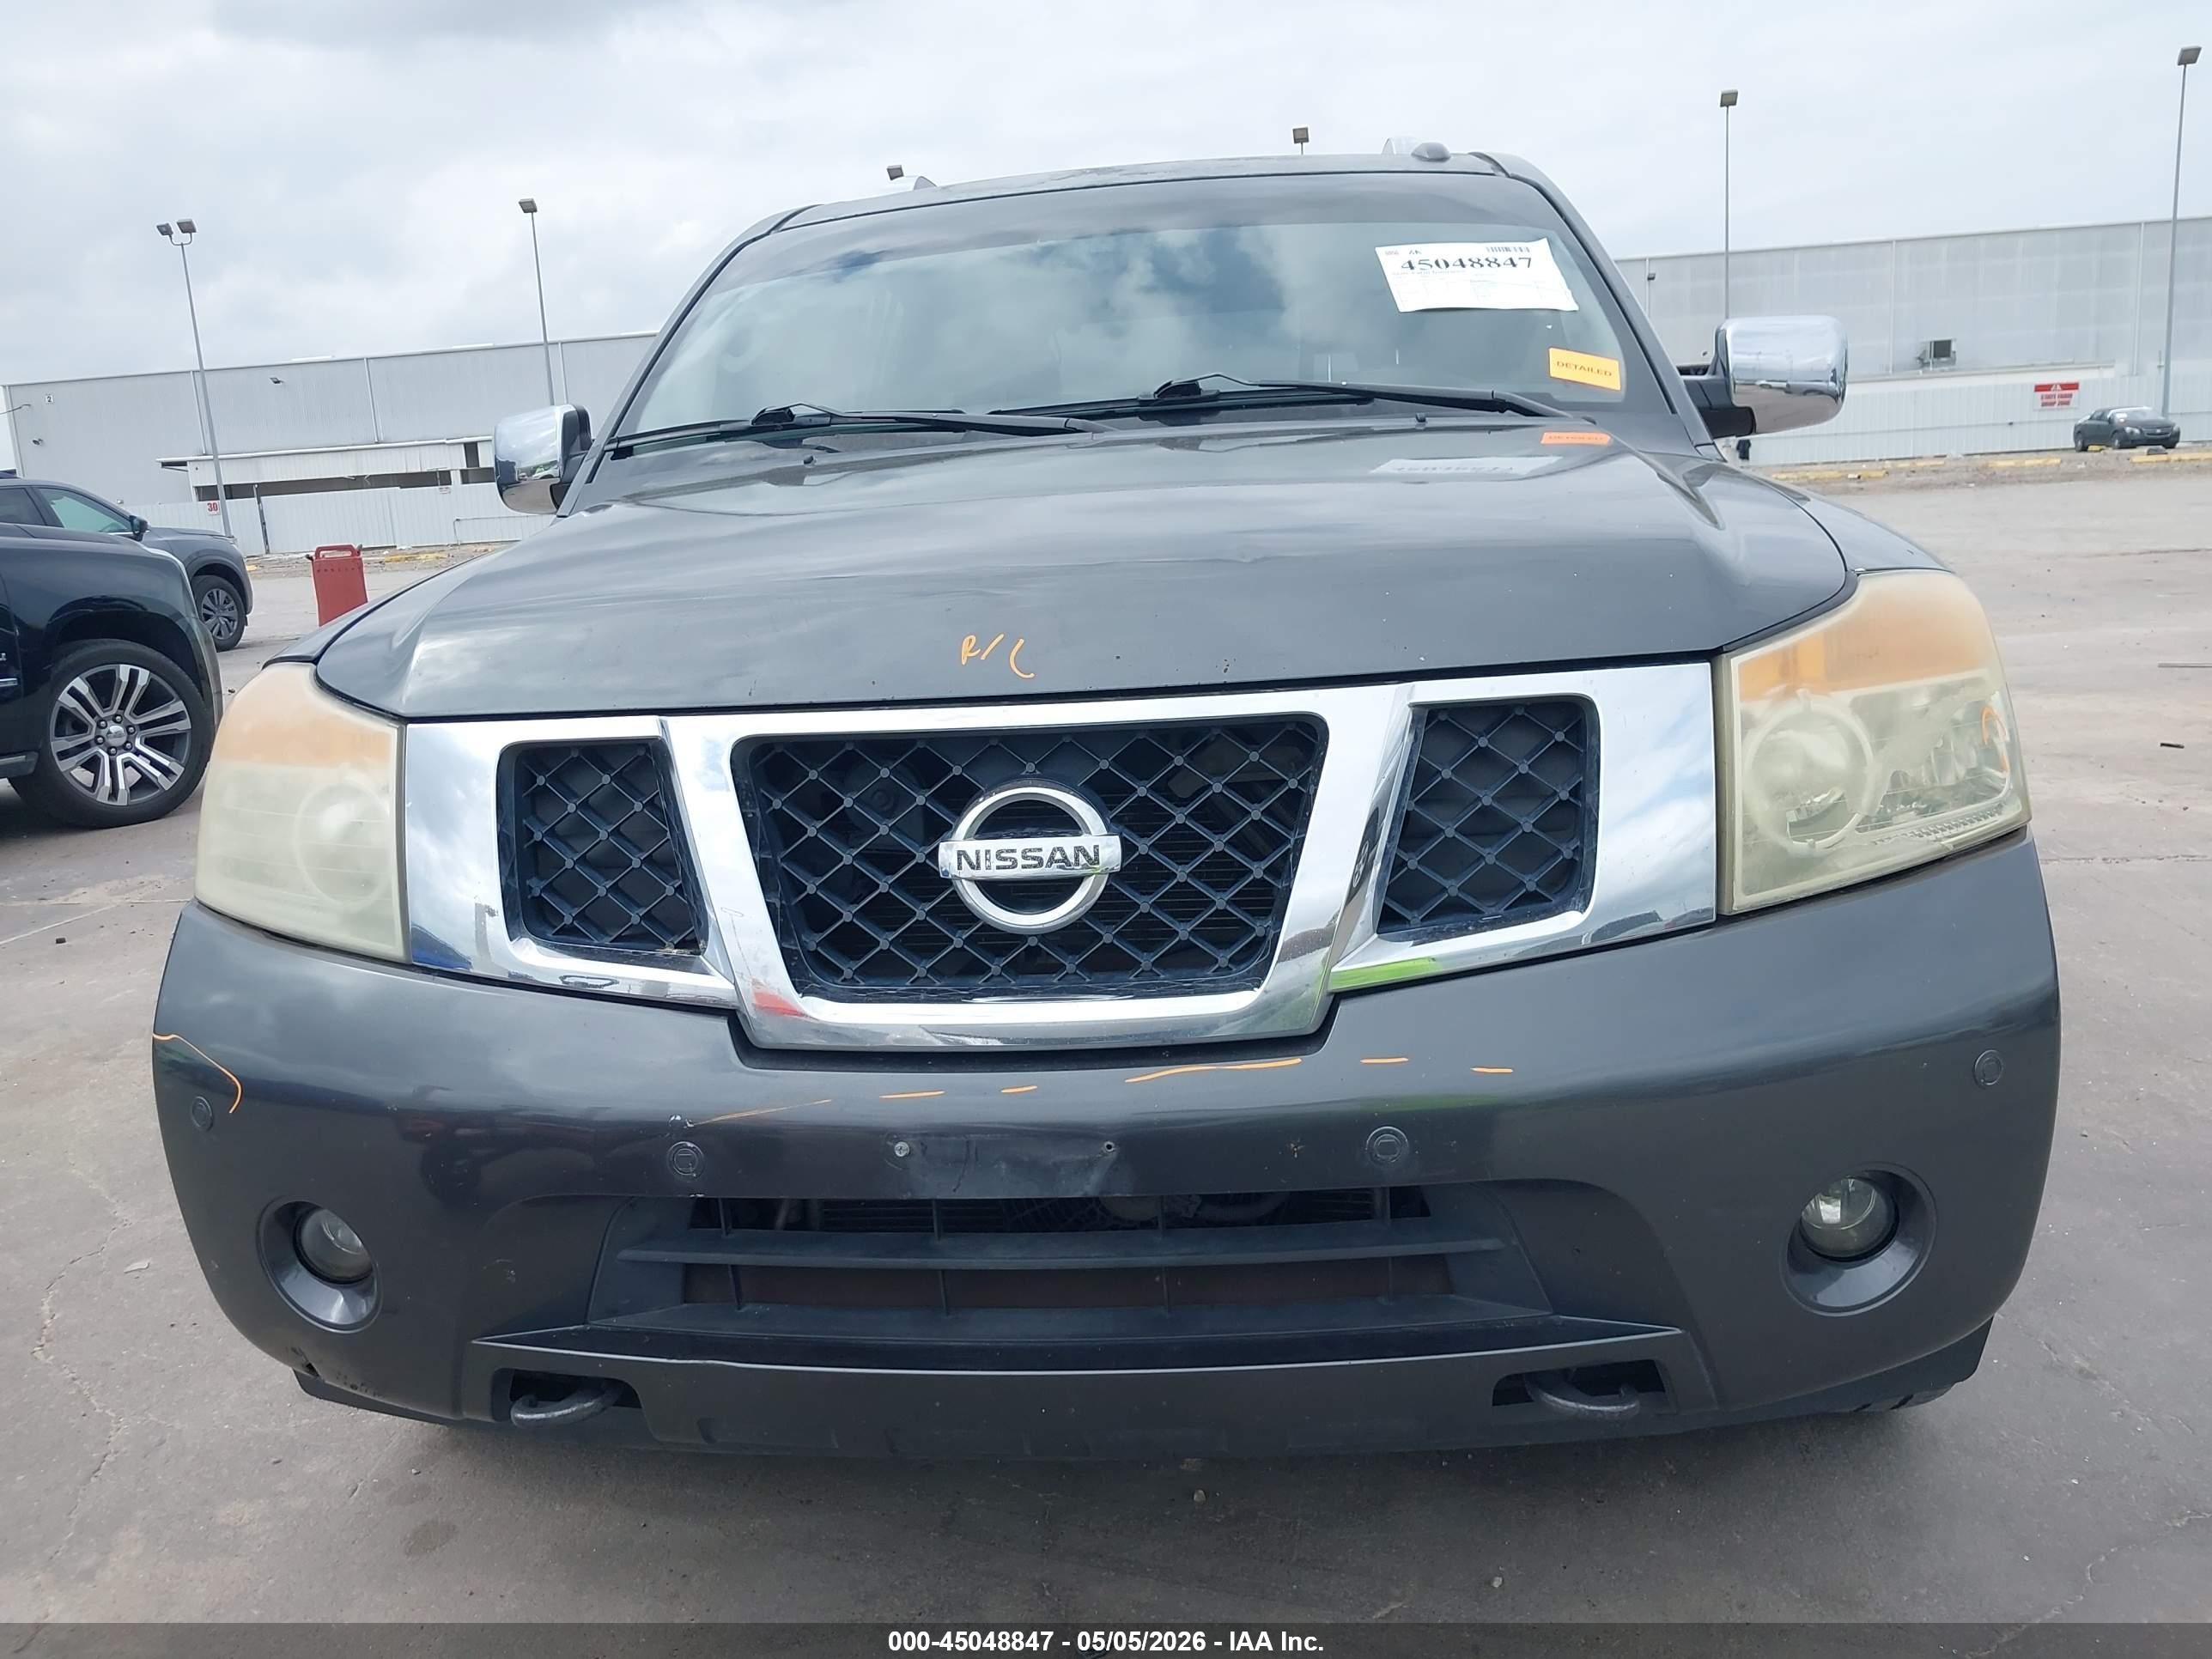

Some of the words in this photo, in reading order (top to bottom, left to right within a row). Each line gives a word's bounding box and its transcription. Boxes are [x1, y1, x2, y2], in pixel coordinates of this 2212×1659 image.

[1401, 257, 1533, 270] 45048847
[1555, 359, 1613, 378] DETAILED
[207, 502, 219, 513] 30
[956, 844, 1101, 872] NISSAN
